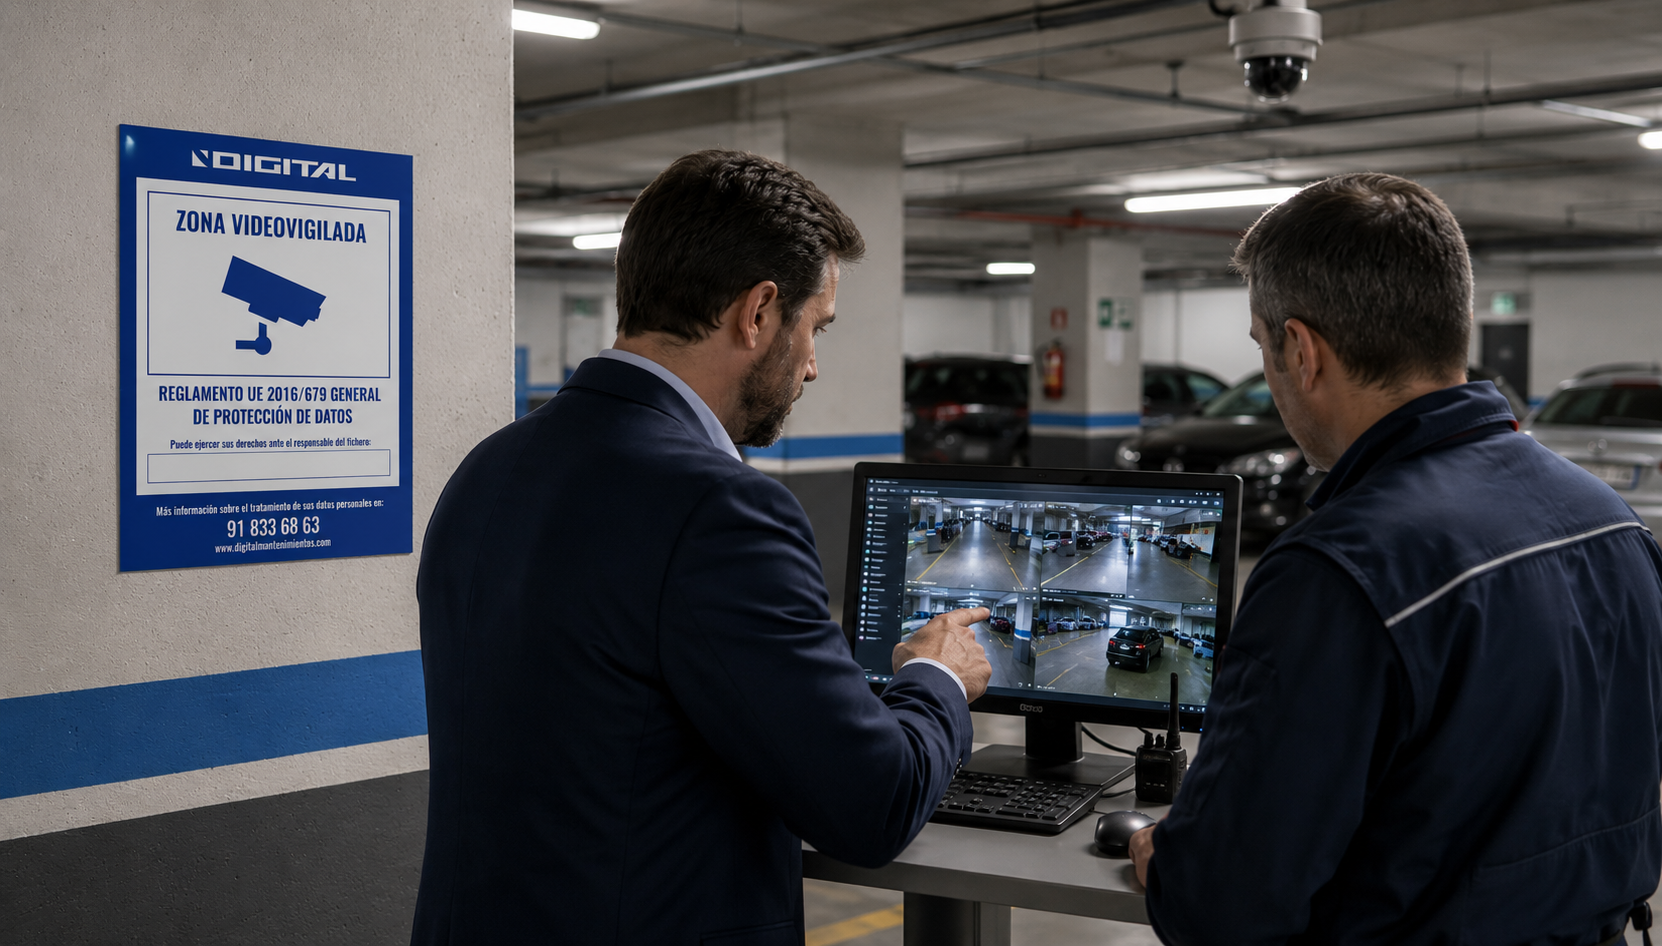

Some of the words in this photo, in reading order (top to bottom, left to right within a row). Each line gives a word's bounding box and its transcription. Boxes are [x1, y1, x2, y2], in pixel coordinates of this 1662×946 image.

[175, 209, 226, 235] ZONA
[231, 213, 367, 244] VIDEOVIGILADA
[158, 385, 244, 402] REGLAMENTO
[247, 386, 264, 402] UE
[267, 386, 327, 402] 2016/679
[330, 387, 382, 402] GENERAL
[193, 408, 210, 425] DE
[213, 405, 292, 425] PROTECCIÓN
[296, 408, 312, 424] DE
[315, 408, 353, 424] DATOS
[170, 439, 194, 450] Puede
[195, 439, 220, 451] ejercer
[222, 440, 234, 449] sus
[236, 438, 268, 449] derechos
[269, 438, 285, 449] ante
[286, 438, 292, 448] el
[294, 437, 334, 450] responsable
[335, 437, 346, 447] del
[347, 437, 371, 447] fichero:
[156, 506, 172, 516] Más
[174, 505, 218, 515] información
[219, 503, 239, 513] sobre
[241, 503, 248, 513] el
[250, 502, 291, 512] tratamiento
[292, 501, 303, 511] de
[336, 498, 373, 510] personales
[374, 499, 384, 507] en:
[227, 519, 244, 538] 91
[250, 517, 277, 537] 833
[281, 516, 298, 535] 68
[302, 515, 320, 534] 63
[214, 538, 332, 553] www.digitalmantenimientos.com
